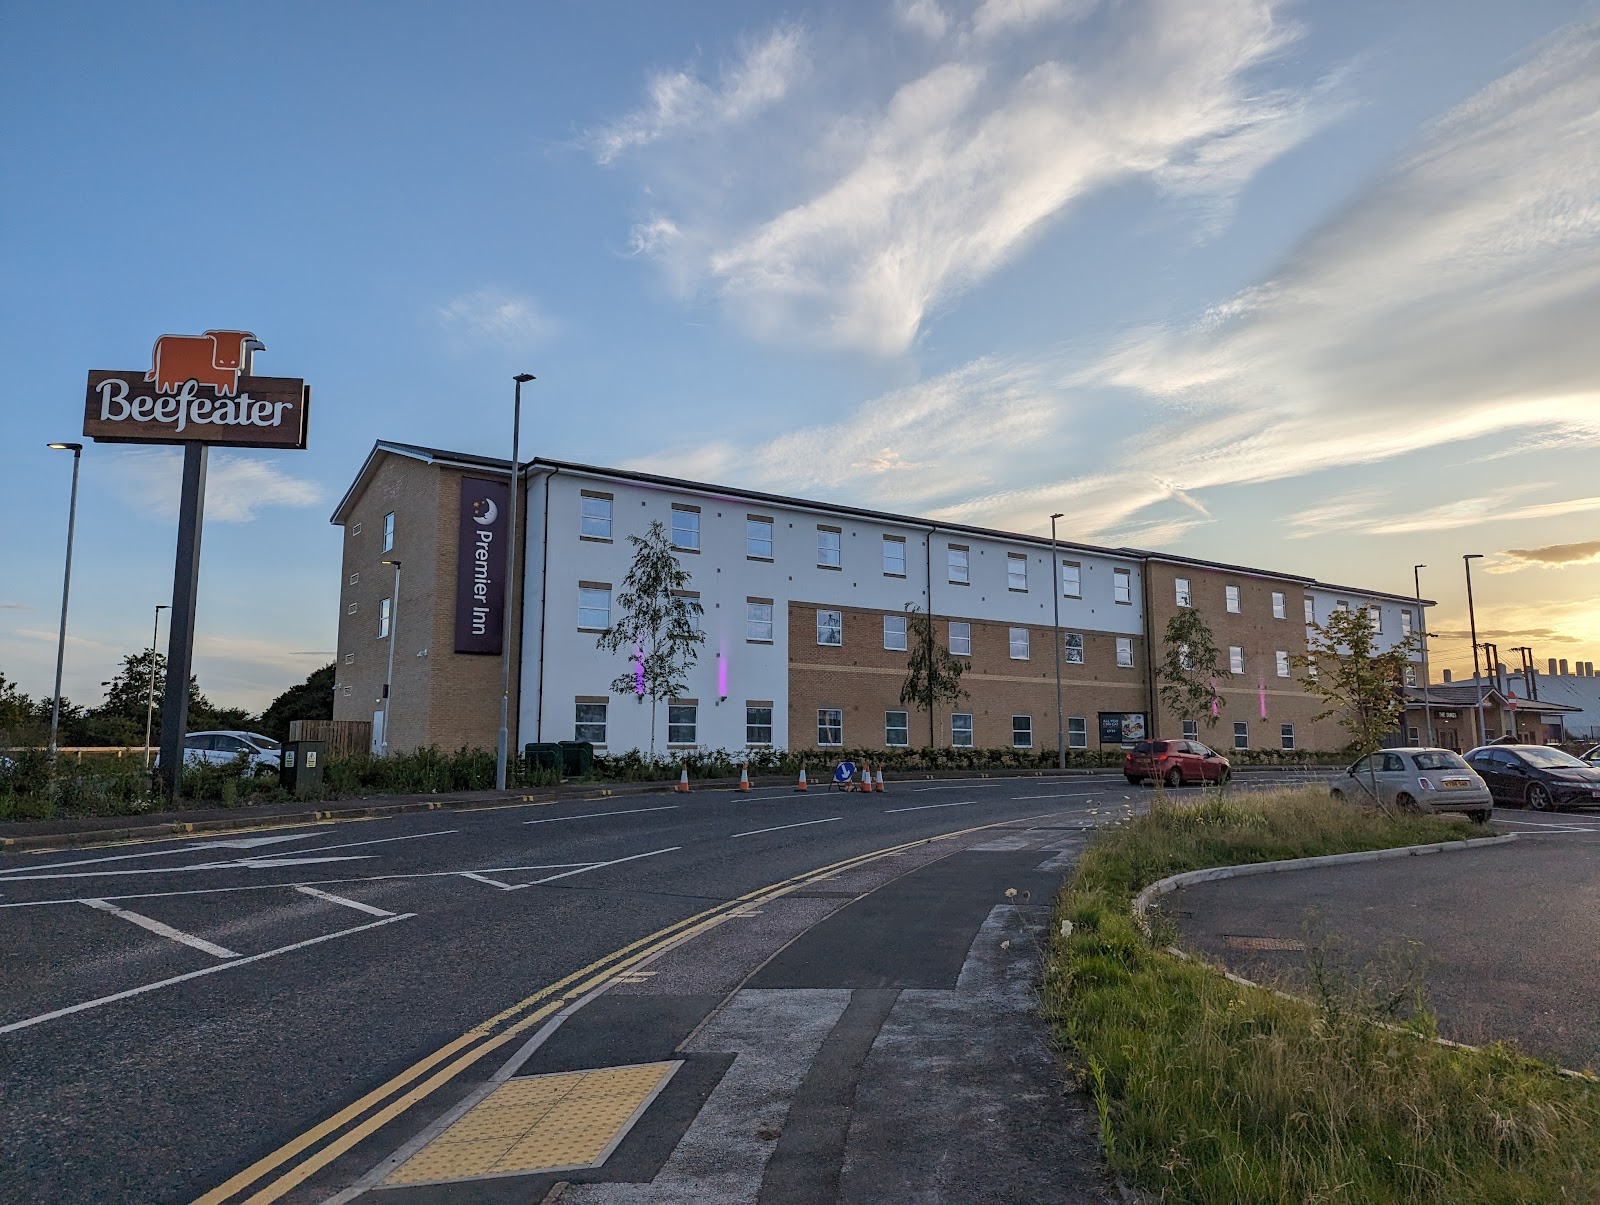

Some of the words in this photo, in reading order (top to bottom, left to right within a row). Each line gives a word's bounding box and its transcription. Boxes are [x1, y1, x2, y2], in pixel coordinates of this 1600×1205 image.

[96, 378, 294, 432] Beefeater
[473, 530, 493, 604] Premier
[472, 607, 490, 635] Inn
